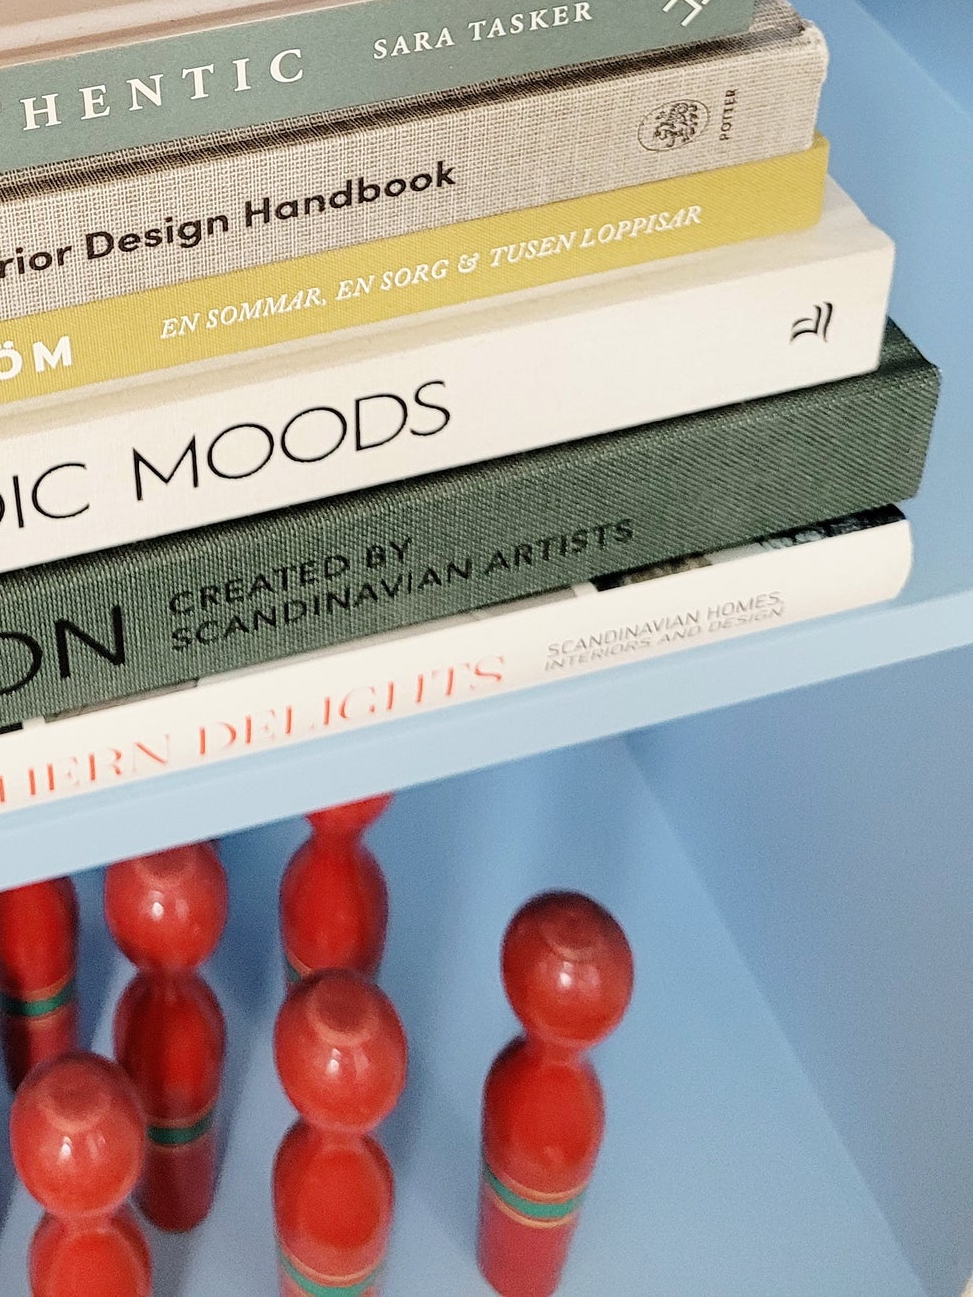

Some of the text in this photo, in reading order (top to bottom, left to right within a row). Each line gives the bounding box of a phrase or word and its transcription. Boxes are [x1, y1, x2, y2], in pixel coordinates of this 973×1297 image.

[372, 1, 594, 60] SARA TASKER
[719, 88, 739, 141] POTTER
[85, 214, 230, 261] Design
[243, 161, 457, 228] Handbook
[159, 205, 703, 340] EN SOMMAR, EN SORG & TUSEN LOPPISAR
[132, 379, 452, 502] MOODS
[167, 536, 414, 616] CREATED BY
[170, 518, 635, 652] SCANDINAVIAN ARTISTS
[544, 607, 786, 672] INTERIORS AND DESIGN
[546, 609, 701, 658] SCANDINAVIAN
[197, 654, 508, 757] DELIGHTS
